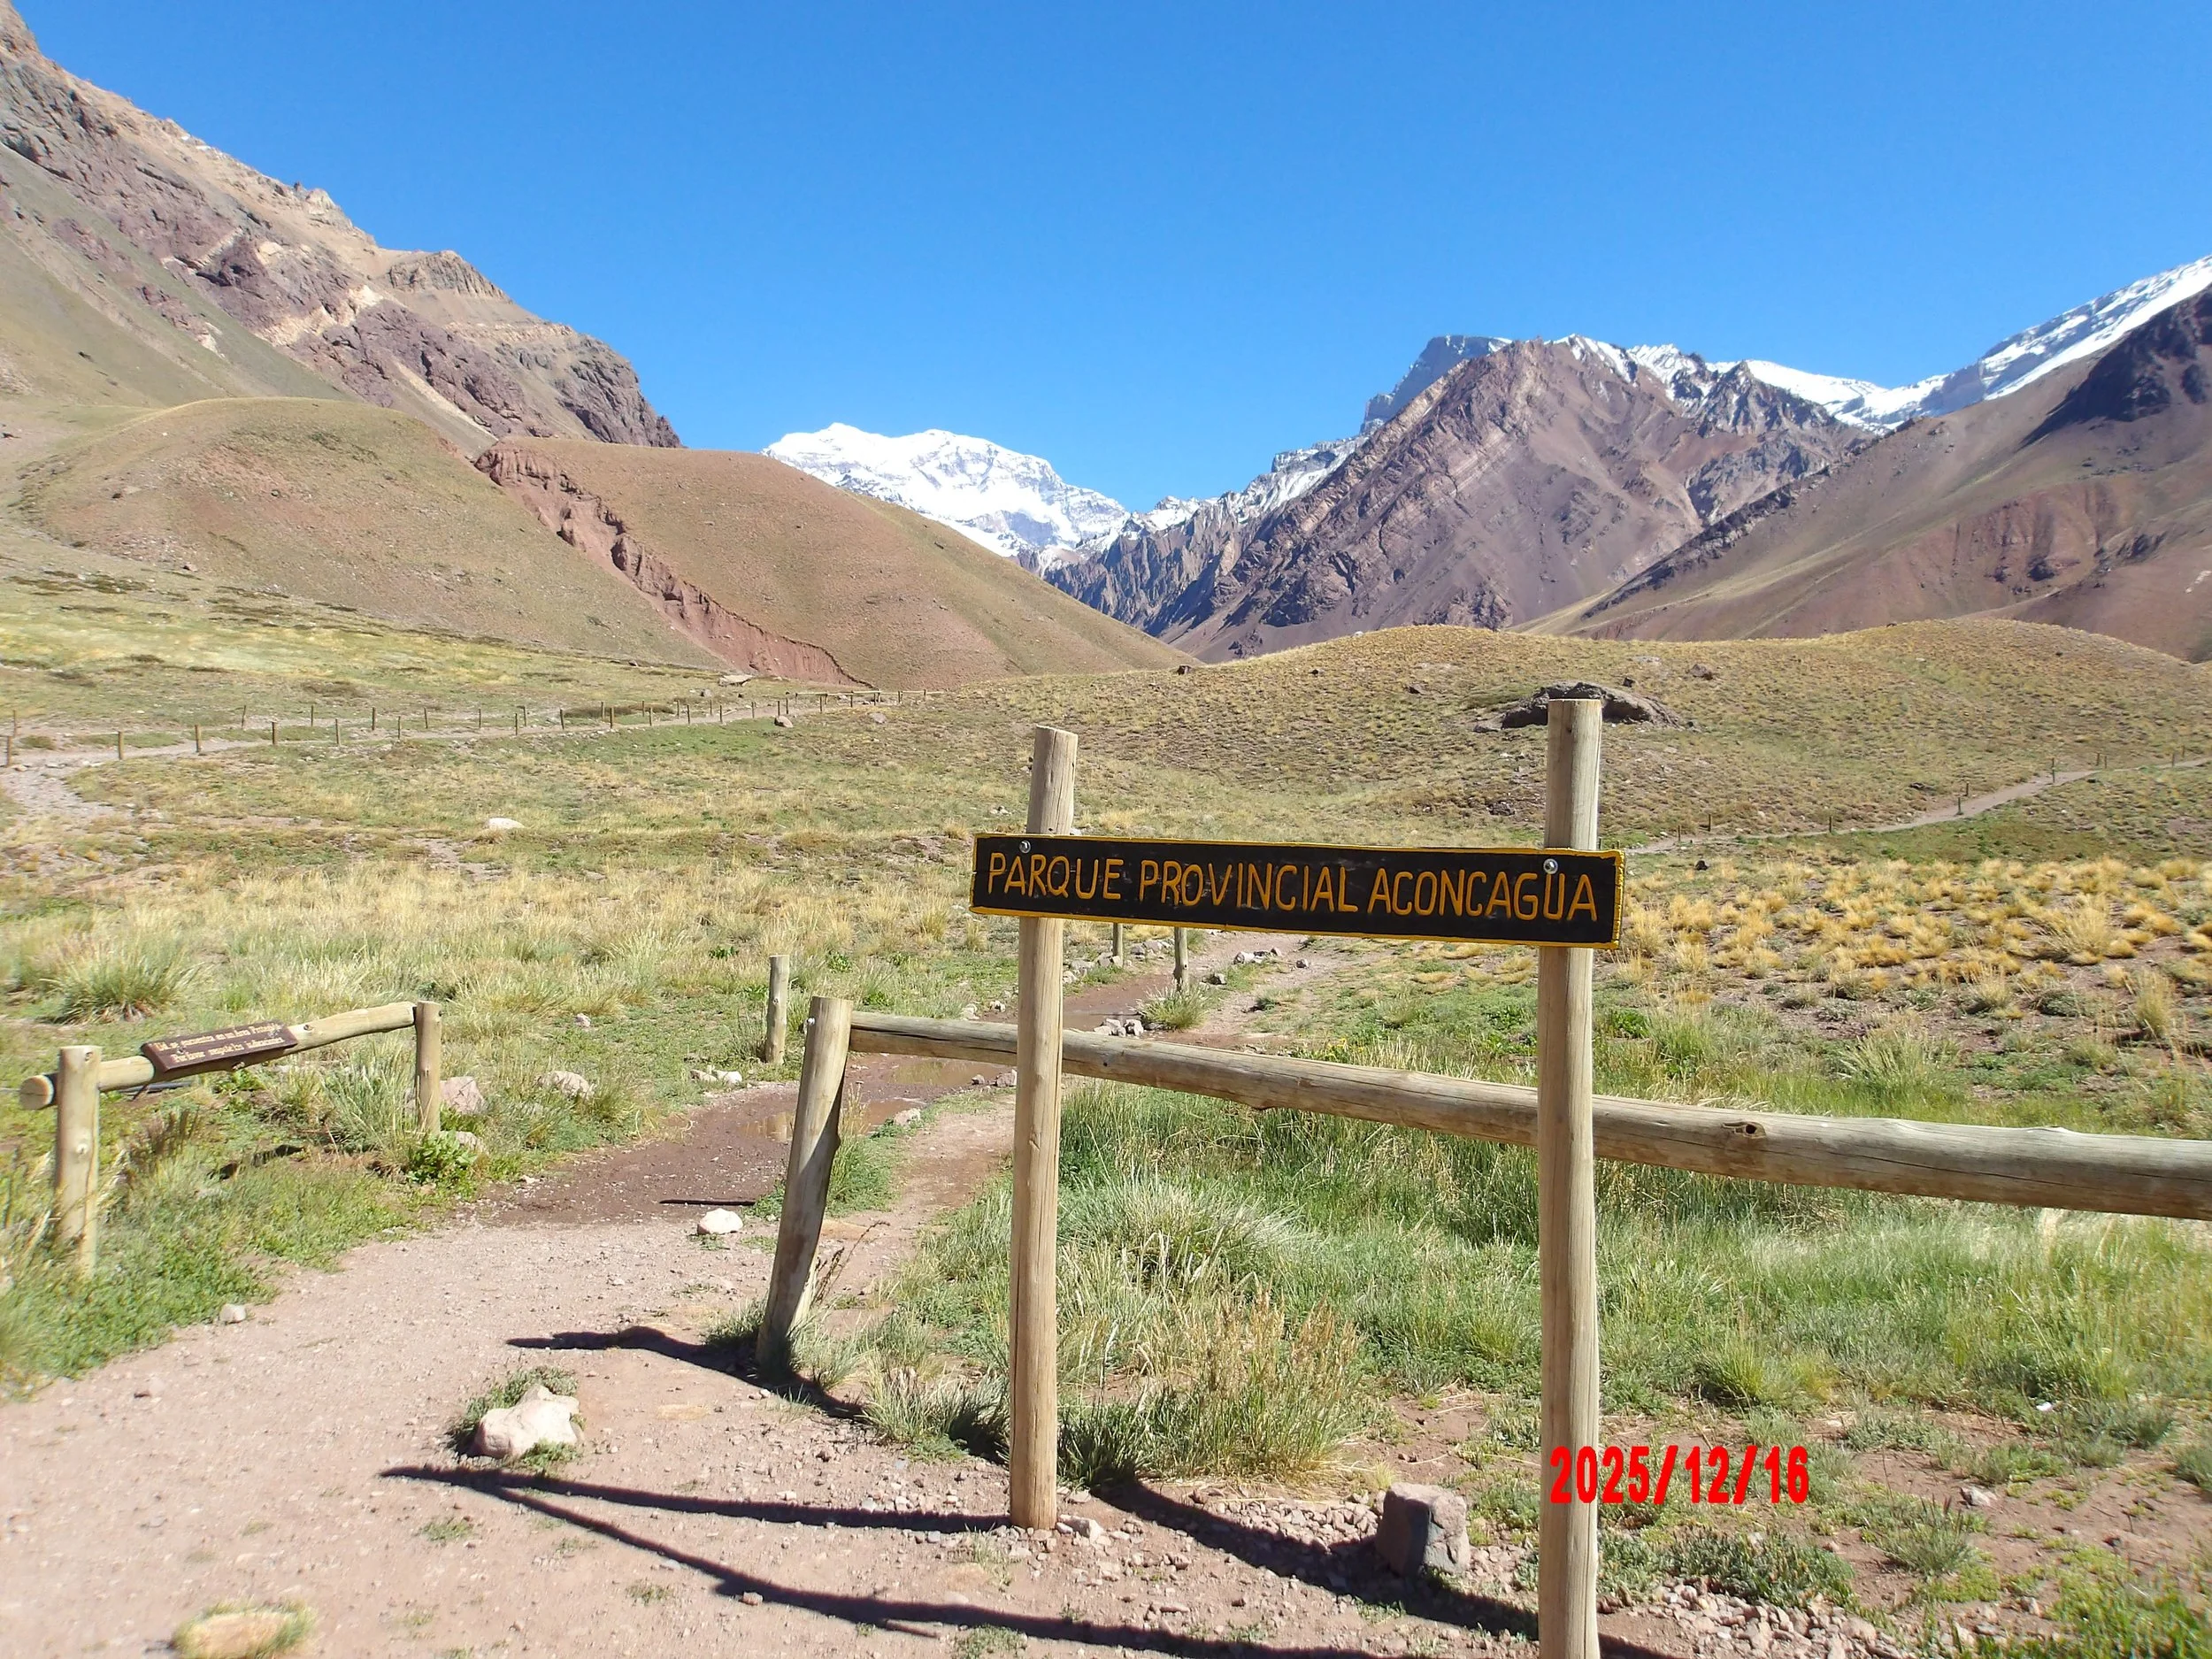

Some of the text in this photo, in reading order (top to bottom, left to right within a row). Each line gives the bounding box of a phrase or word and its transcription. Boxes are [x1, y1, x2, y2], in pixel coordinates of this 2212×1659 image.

[987, 852, 1598, 921] PARQUE PROVINCIAL ACONCAGUA
